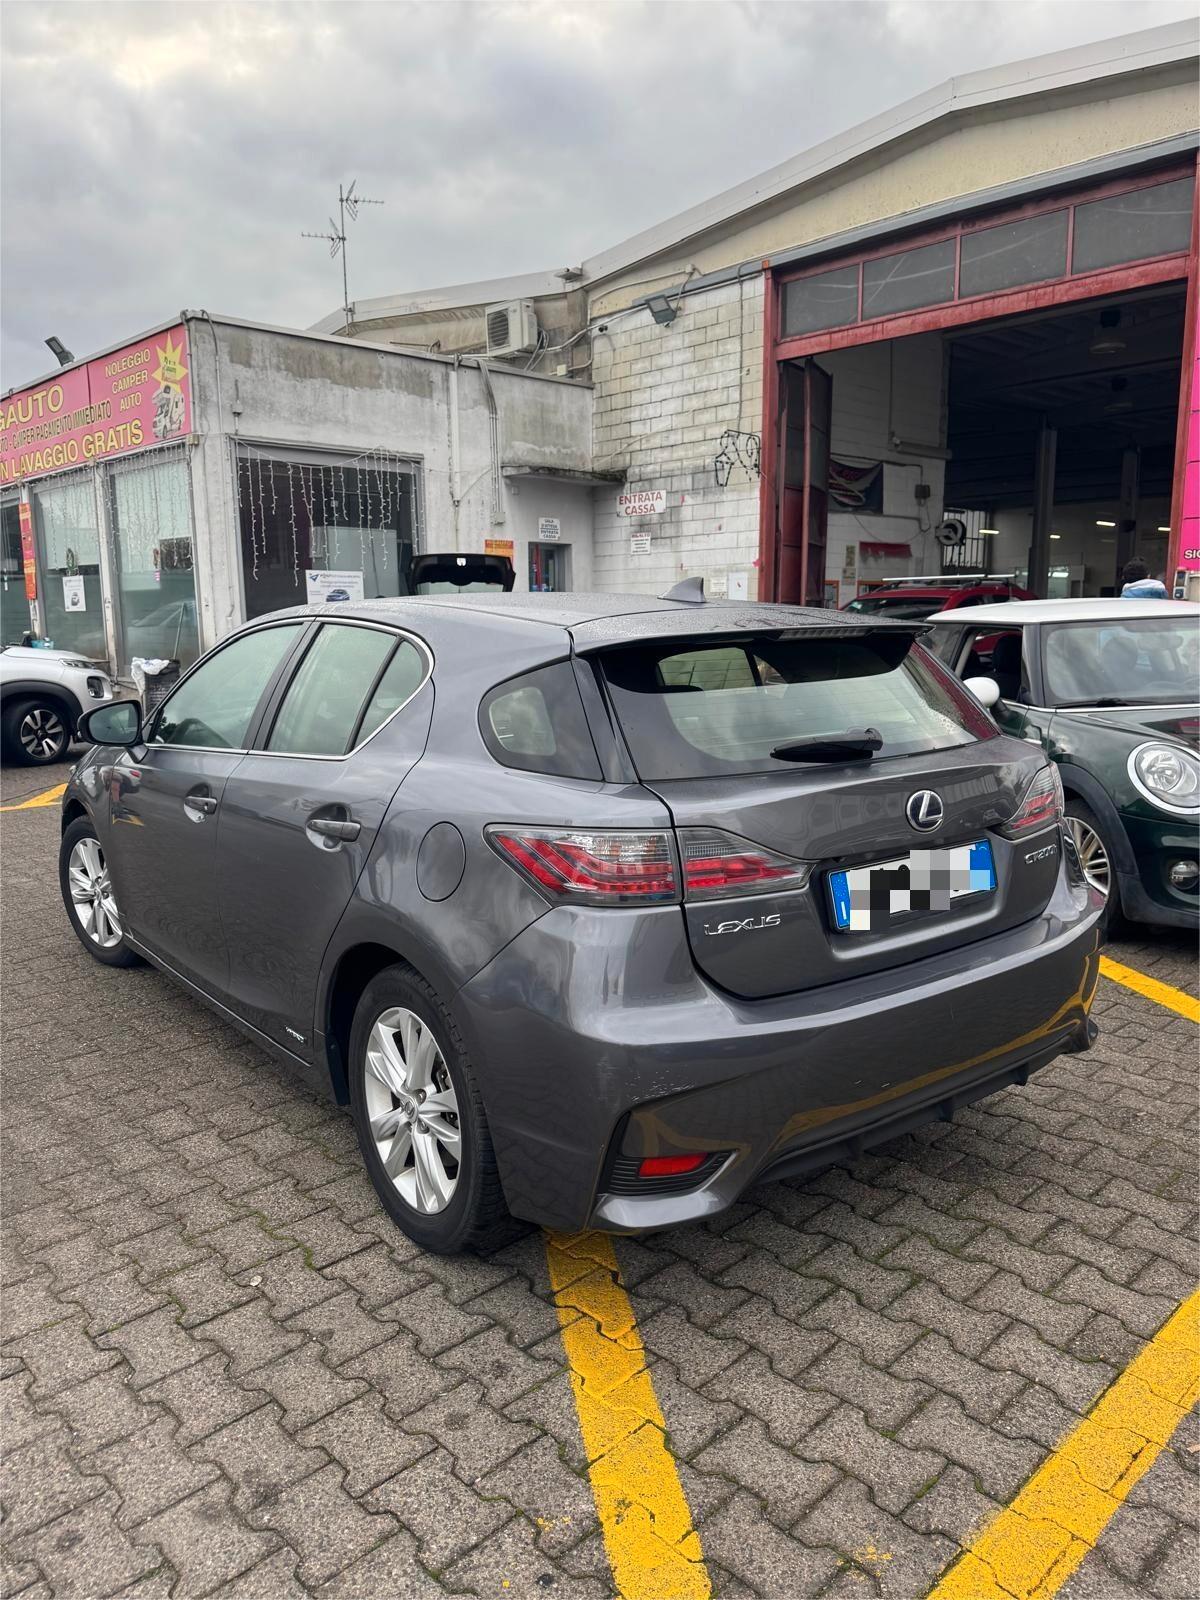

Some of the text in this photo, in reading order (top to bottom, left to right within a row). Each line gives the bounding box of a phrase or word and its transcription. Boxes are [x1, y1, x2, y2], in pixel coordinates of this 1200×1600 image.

[105, 348, 151, 377] NOLEGGIO
[112, 369, 148, 394] CAMPER
[120, 392, 142, 412] AUTO
[13, 426, 34, 449] CAMPER
[36, 412, 71, 441] PAGAMENTO
[72, 400, 112, 430] IMMEDIATO
[12, 439, 78, 477] LAVAGGIO
[82, 418, 144, 458] GRATIS
[619, 491, 663, 505] ENTRATA
[625, 503, 656, 515] CASSA
[704, 913, 781, 935] LEXUS
